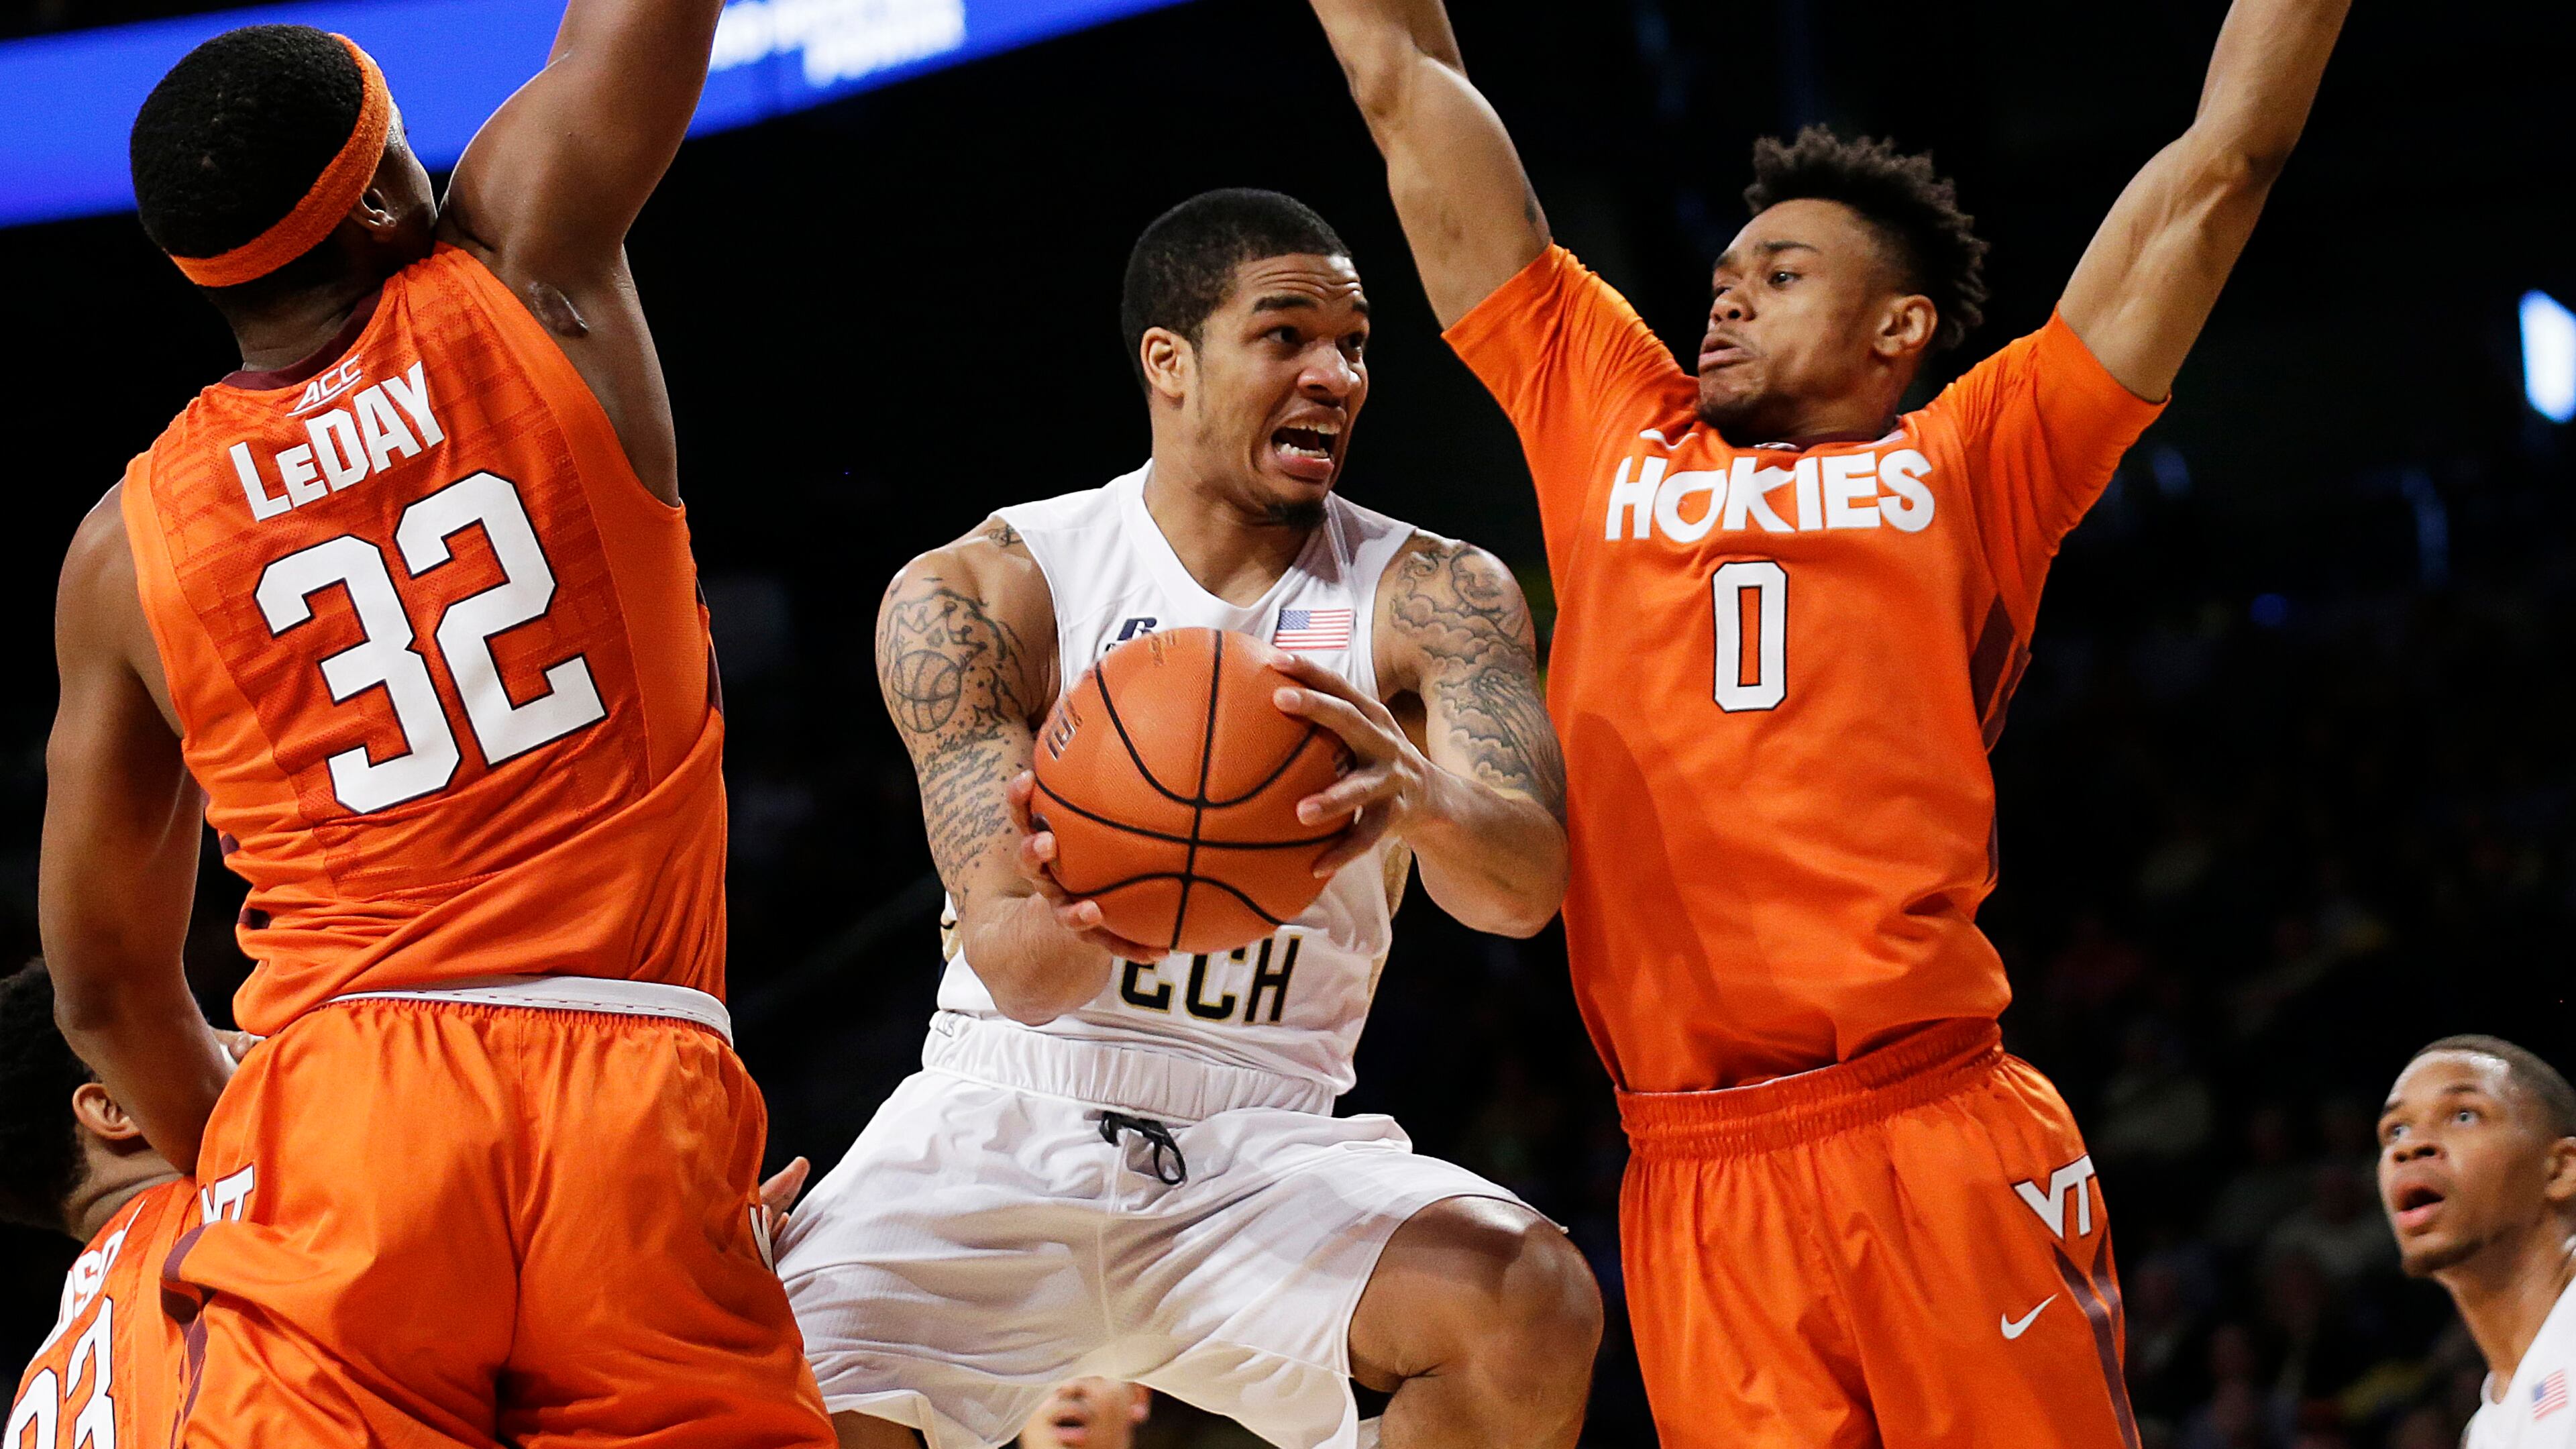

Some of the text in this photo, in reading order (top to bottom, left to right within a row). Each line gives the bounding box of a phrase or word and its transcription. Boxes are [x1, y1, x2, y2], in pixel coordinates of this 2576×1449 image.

[293, 354, 362, 411] ACC
[229, 360, 445, 521] LeDAY
[1605, 448, 1935, 543] HOKIES
[254, 471, 608, 814] 32
[1712, 560, 1788, 714] 0
[1119, 934, 1303, 1024] ECH
[2010, 1152, 2095, 1240] VT
